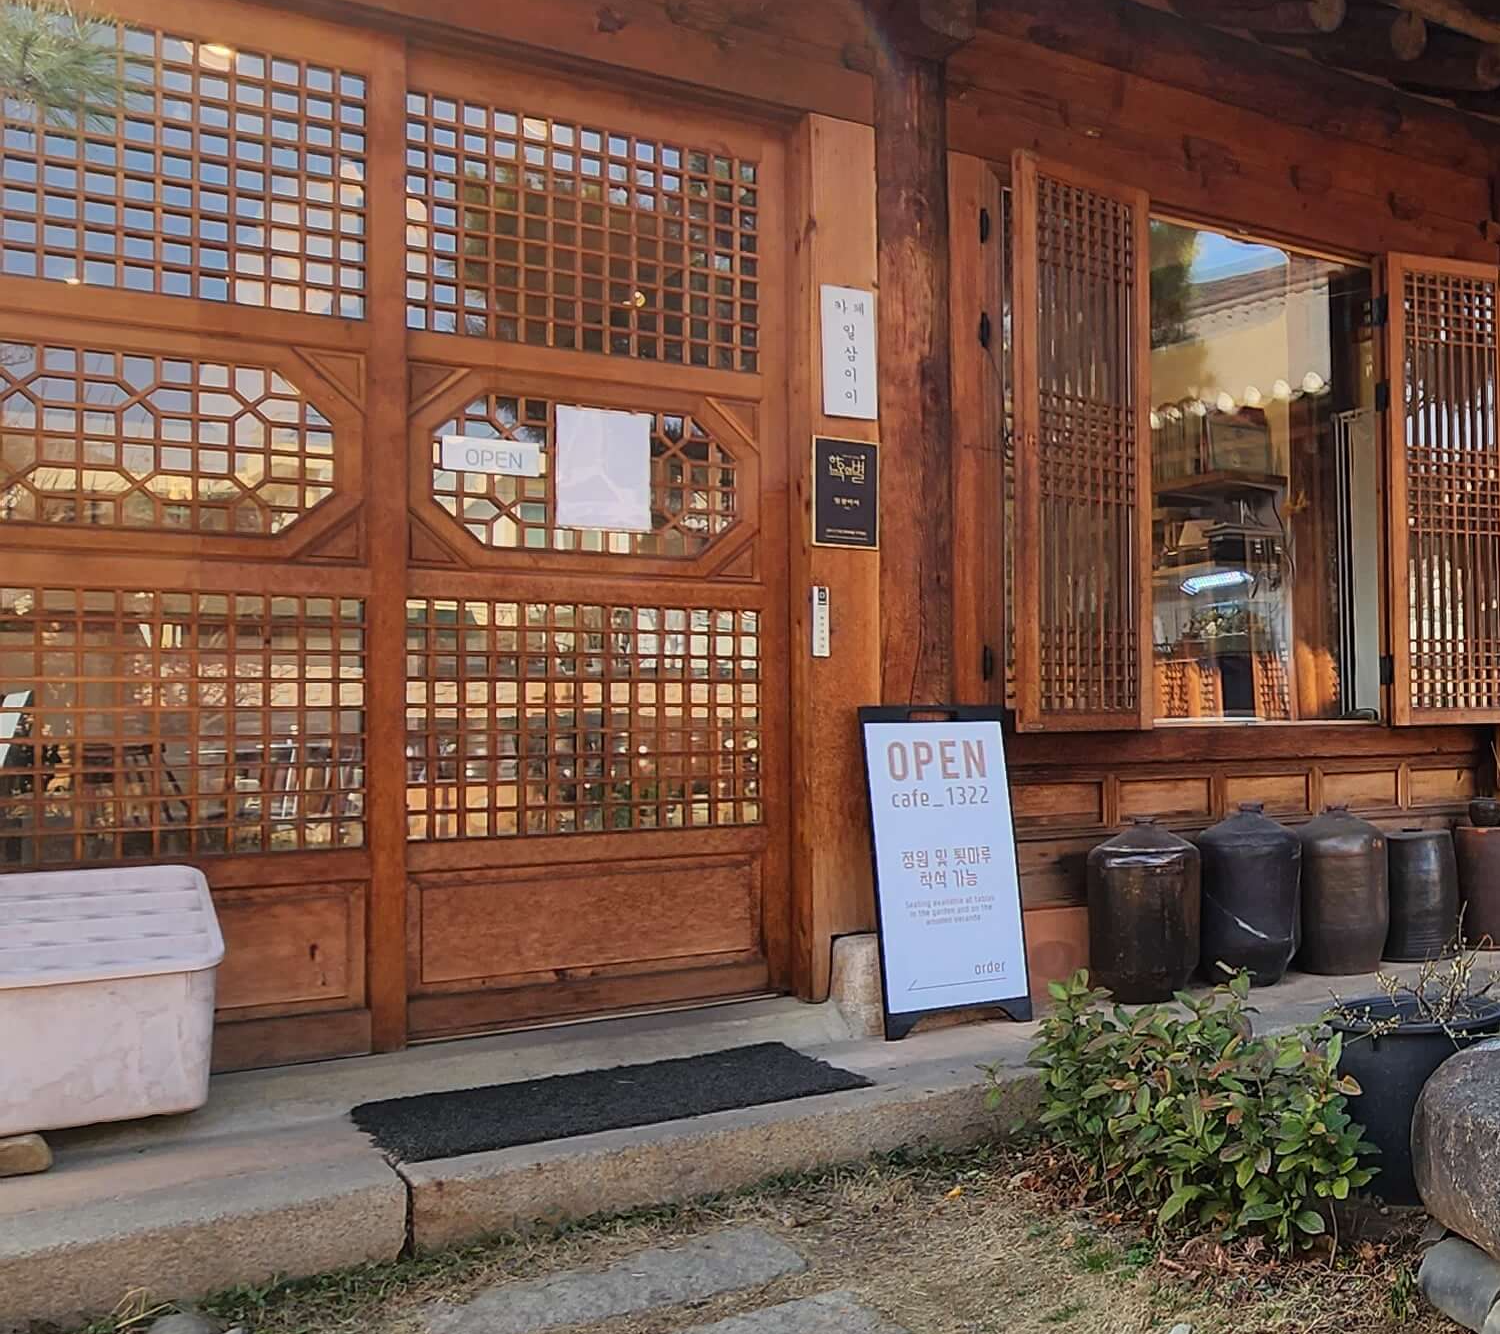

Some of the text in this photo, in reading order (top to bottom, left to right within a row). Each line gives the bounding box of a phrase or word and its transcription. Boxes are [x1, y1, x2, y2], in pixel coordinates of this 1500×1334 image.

[465, 448, 523, 469] OPEN
[886, 739, 987, 781] OPEN
[891, 785, 990, 808] cafe_1322
[901, 850, 929, 869] 정원
[935, 848, 948, 868] 및
[920, 868, 978, 889] 착석 가능
[974, 961, 1006, 976] order
